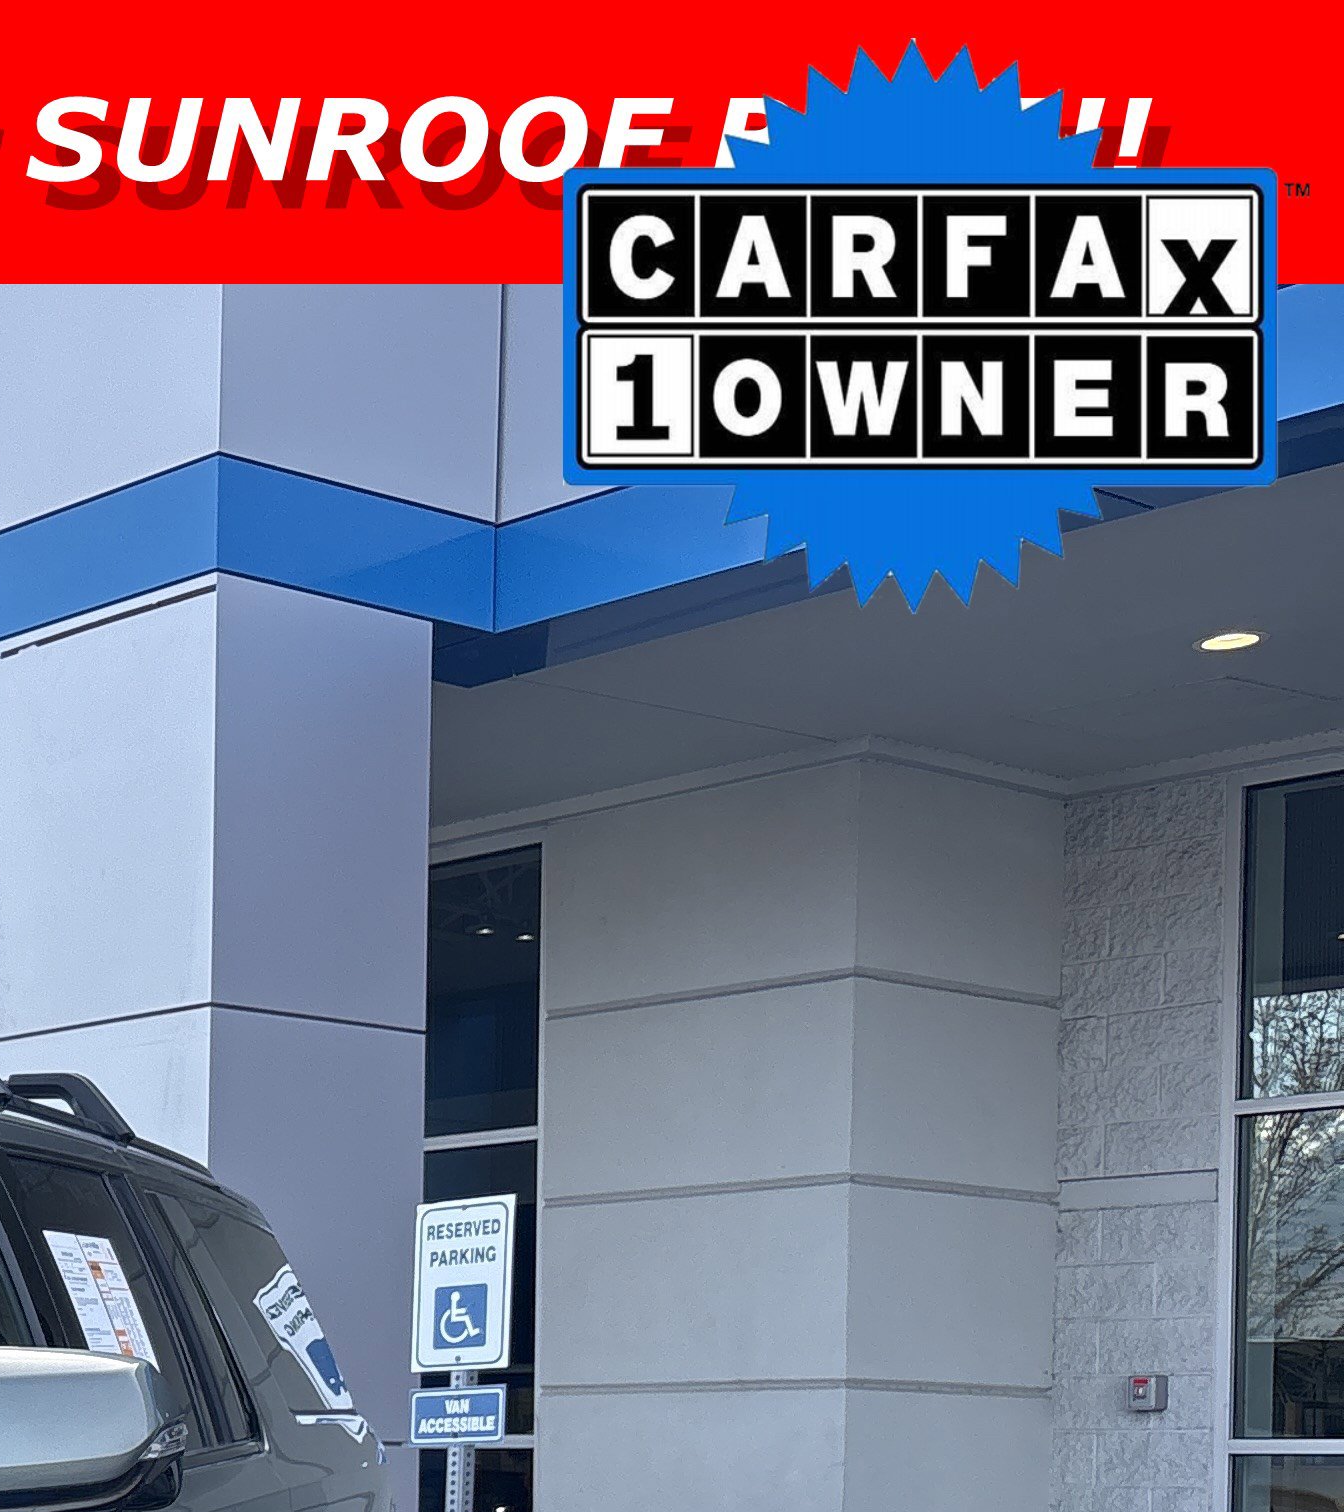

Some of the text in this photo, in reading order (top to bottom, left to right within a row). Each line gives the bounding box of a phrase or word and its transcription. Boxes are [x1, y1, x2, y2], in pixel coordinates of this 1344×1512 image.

[426, 1218, 502, 1242] RESERVED
[429, 1245, 497, 1268] PARKING
[444, 1398, 471, 1415] VAN
[417, 1415, 496, 1435] ACCESSIBLE
